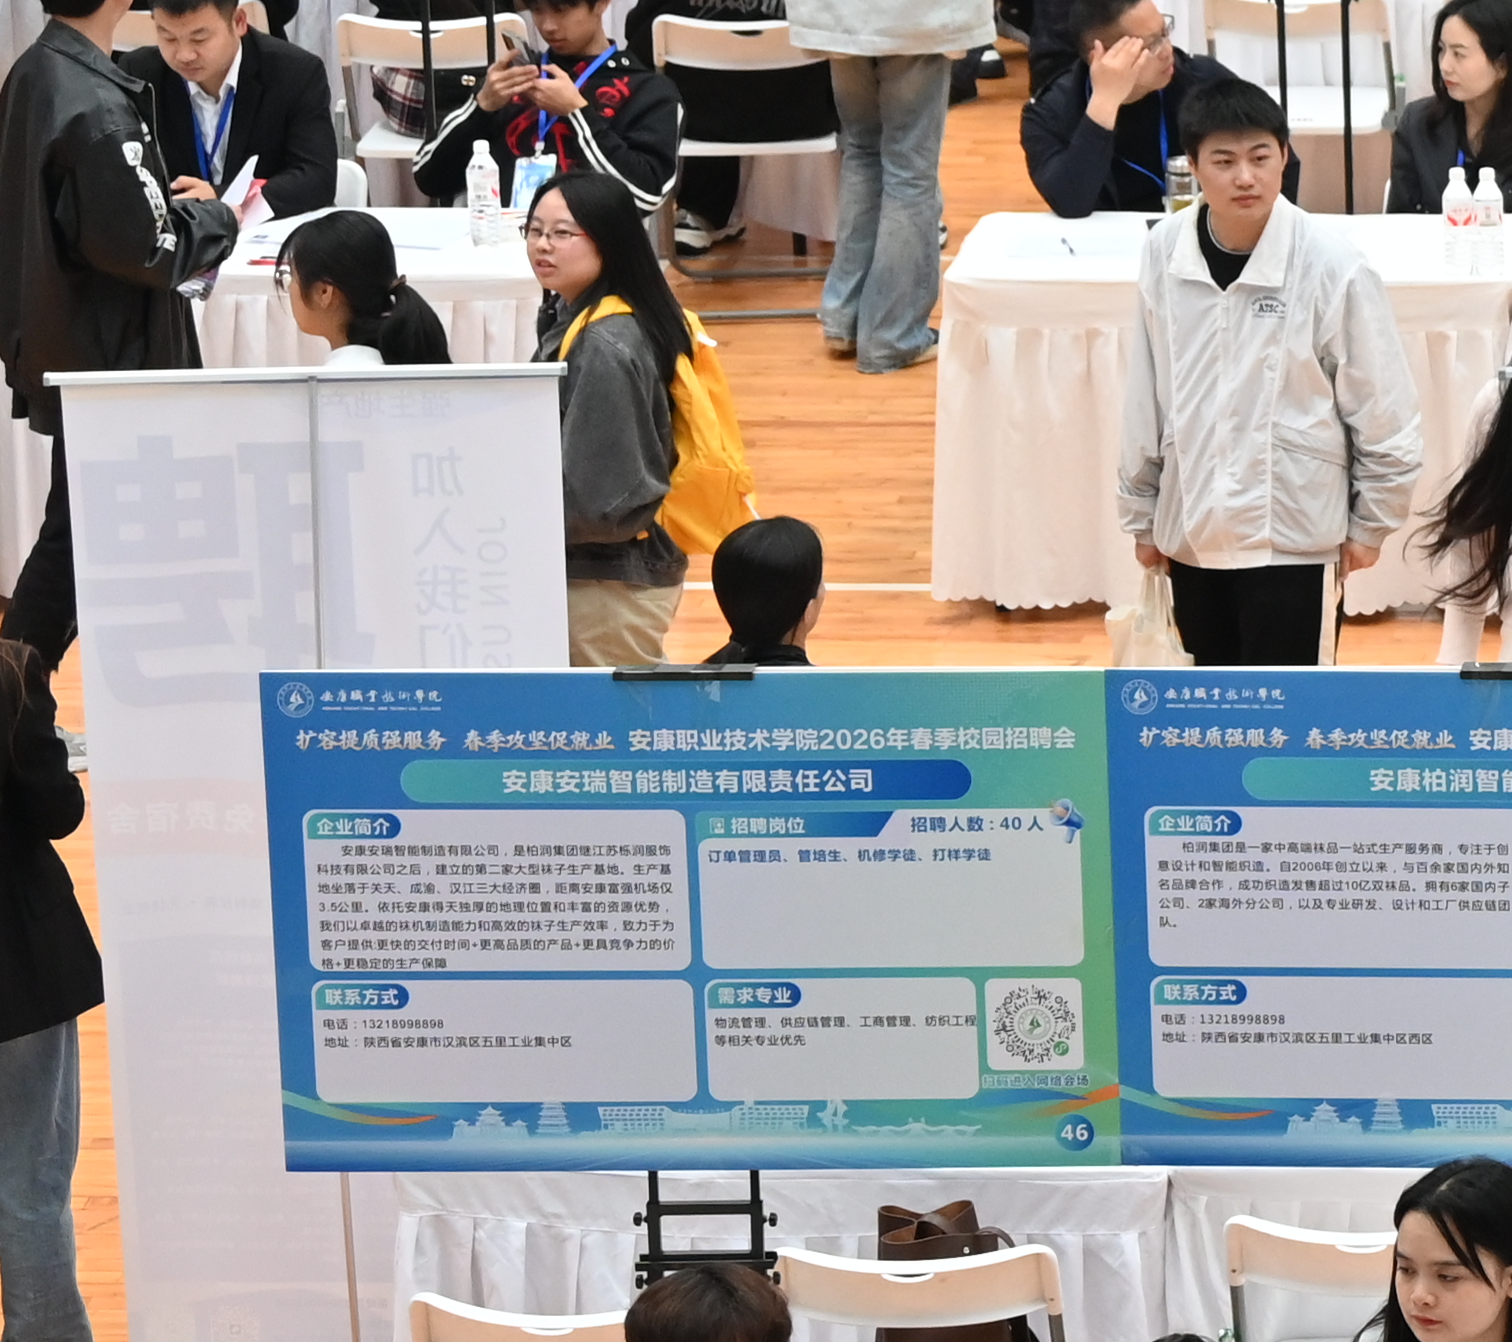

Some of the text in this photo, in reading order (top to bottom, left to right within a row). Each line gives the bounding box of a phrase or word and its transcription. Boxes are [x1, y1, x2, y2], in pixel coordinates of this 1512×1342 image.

[294, 725, 1076, 753] 扩容提质强服务 春季攻坚促就业 安康职业技术学院2026年春季校园招聘会
[1138, 726, 1290, 751] 扩容提质强服务
[1303, 728, 1455, 752] 春季攻坚促就业
[501, 766, 874, 796] 安康安瑞智能制造有限责任公司
[316, 816, 392, 838] 企业简介
[731, 815, 806, 836] 招聘岗位
[1157, 813, 1232, 835] 企业简介
[707, 847, 993, 863] 订单管理员、管培生、机修学徒、打样学徒
[320, 956, 448, 971] 格+更稳定的生产保障
[324, 986, 400, 1008] 联系方式
[716, 984, 794, 1006] 需求专业
[1162, 983, 1238, 1003] 联系方式
[714, 1014, 978, 1030] 物流管理、供应链管理、工商管理、纺织工程
[714, 1033, 807, 1048] 等相关专业优先
[1059, 1123, 1089, 1141] 46
